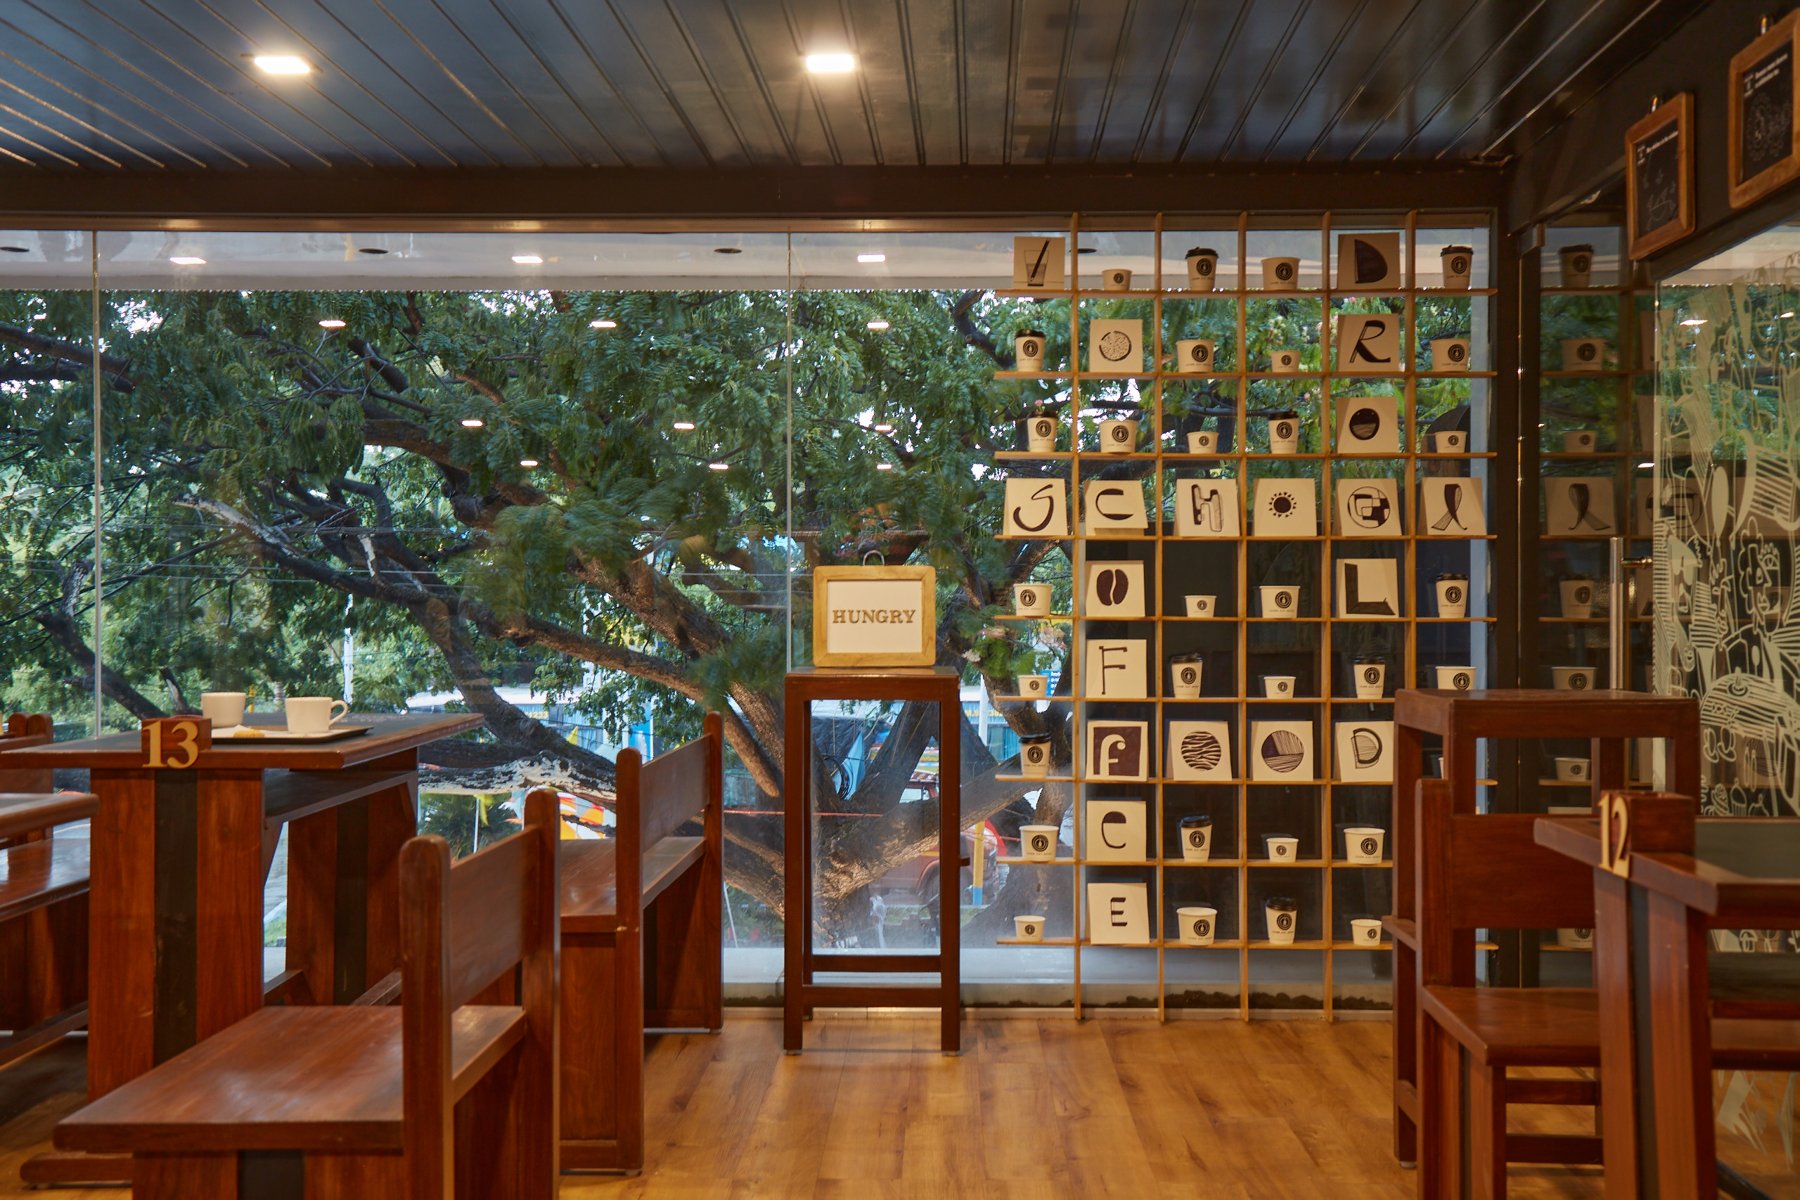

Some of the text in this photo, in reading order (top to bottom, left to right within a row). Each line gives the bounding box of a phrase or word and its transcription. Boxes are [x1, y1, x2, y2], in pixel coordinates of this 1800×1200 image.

[832, 609, 916, 624] HUNGRY
[142, 720, 199, 769] 13
[1598, 793, 1631, 878] 12
